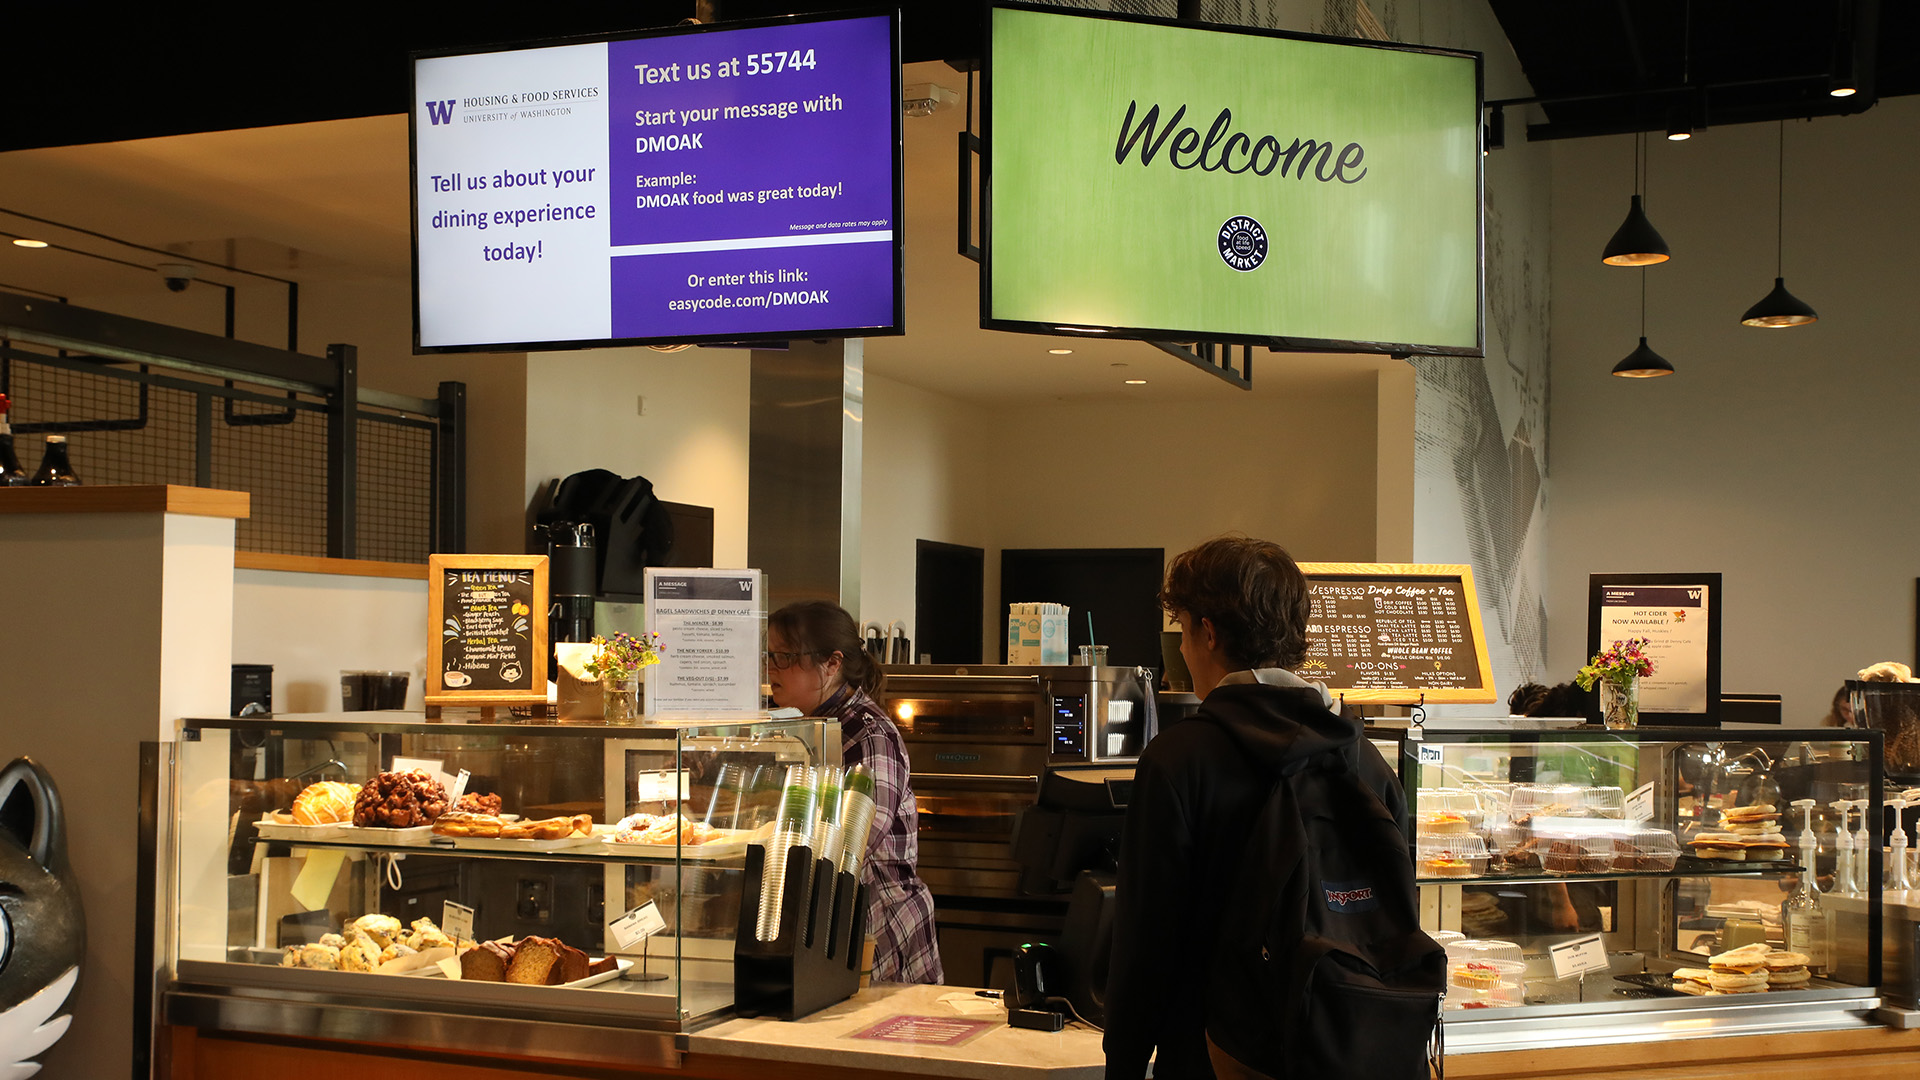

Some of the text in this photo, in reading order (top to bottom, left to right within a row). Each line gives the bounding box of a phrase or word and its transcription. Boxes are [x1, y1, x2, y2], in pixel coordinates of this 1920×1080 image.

[635, 49, 816, 84] Text us at 55744
[464, 87, 599, 107] HOUSING & FOOD SERVICES
[426, 100, 456, 125] W
[464, 108, 571, 123] UNIVERSITY of WASHINGTON
[635, 94, 843, 126] Start your message with
[636, 133, 703, 153] DMOAK
[1115, 100, 1367, 184] Welcome
[431, 168, 595, 192] Tell us about your
[637, 172, 697, 187] Example:
[637, 182, 842, 209] DMOAK food was great today!
[432, 204, 596, 229] dining experience
[1221, 219, 1264, 241] DISTRICT
[483, 240, 542, 263] today!
[1223, 248, 1262, 268] MARKET
[688, 269, 808, 287] Or enter this link:
[669, 290, 829, 312] easycode.com/DMOAK
[462, 571, 515, 583] TEA MENU
[739, 581, 752, 591] W
[1319, 586, 1365, 595] ESPRESSO
[1368, 585, 1393, 596] Drip
[1395, 586, 1426, 597] Coffee
[1438, 587, 1455, 595] Tea
[1687, 590, 1702, 599] W
[488, 604, 498, 612] Tea
[1324, 625, 1371, 633] ESPRESSO
